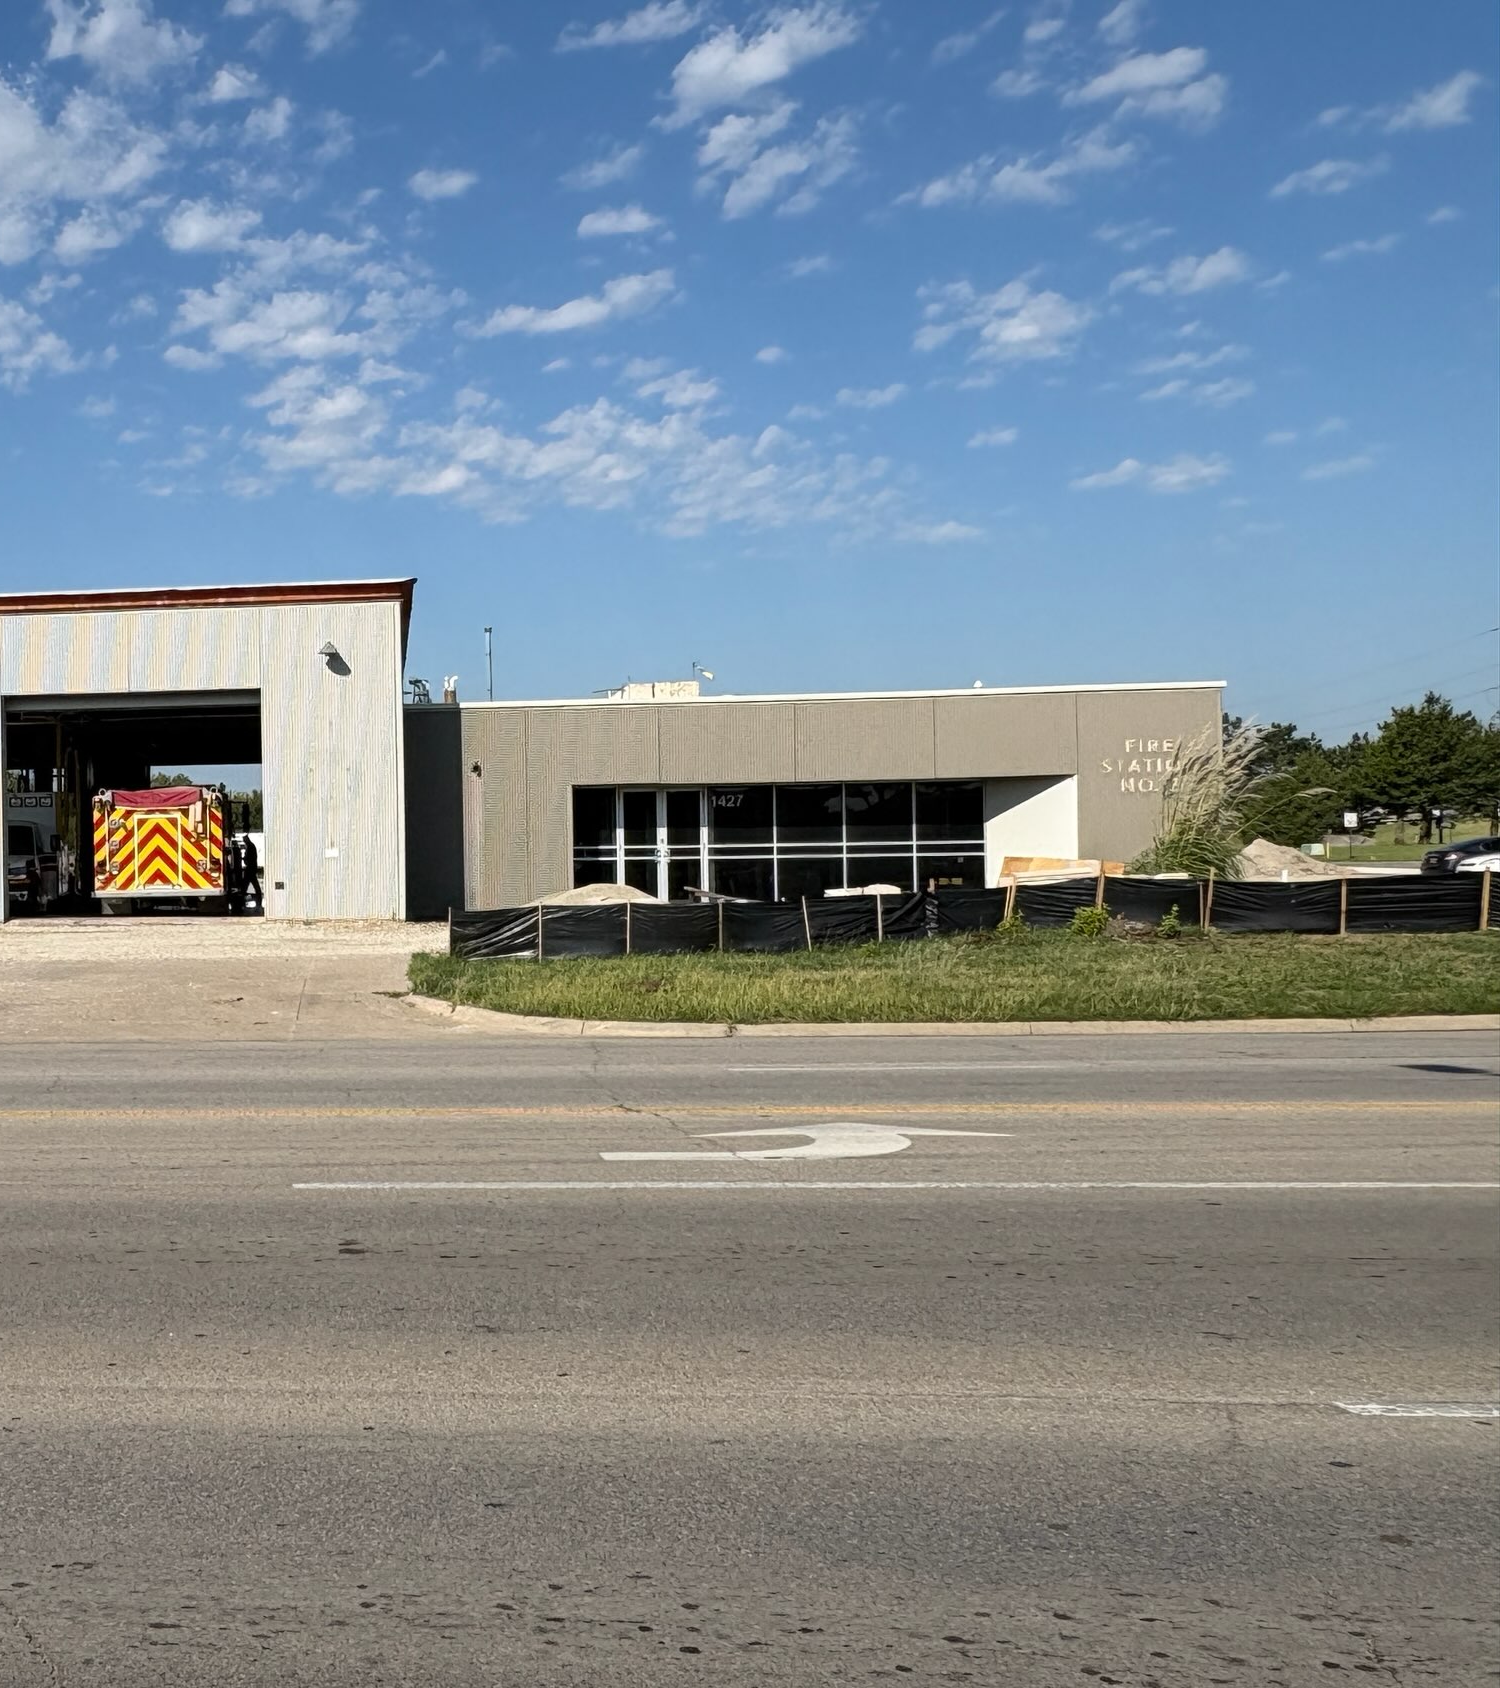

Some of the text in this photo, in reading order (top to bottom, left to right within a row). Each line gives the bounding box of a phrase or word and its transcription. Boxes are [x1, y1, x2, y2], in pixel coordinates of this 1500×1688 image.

[1125, 738, 1174, 753] FIRE
[1100, 758, 1184, 773] STATIO
[1120, 777, 1159, 793] NO.
[711, 794, 744, 808] 1427
